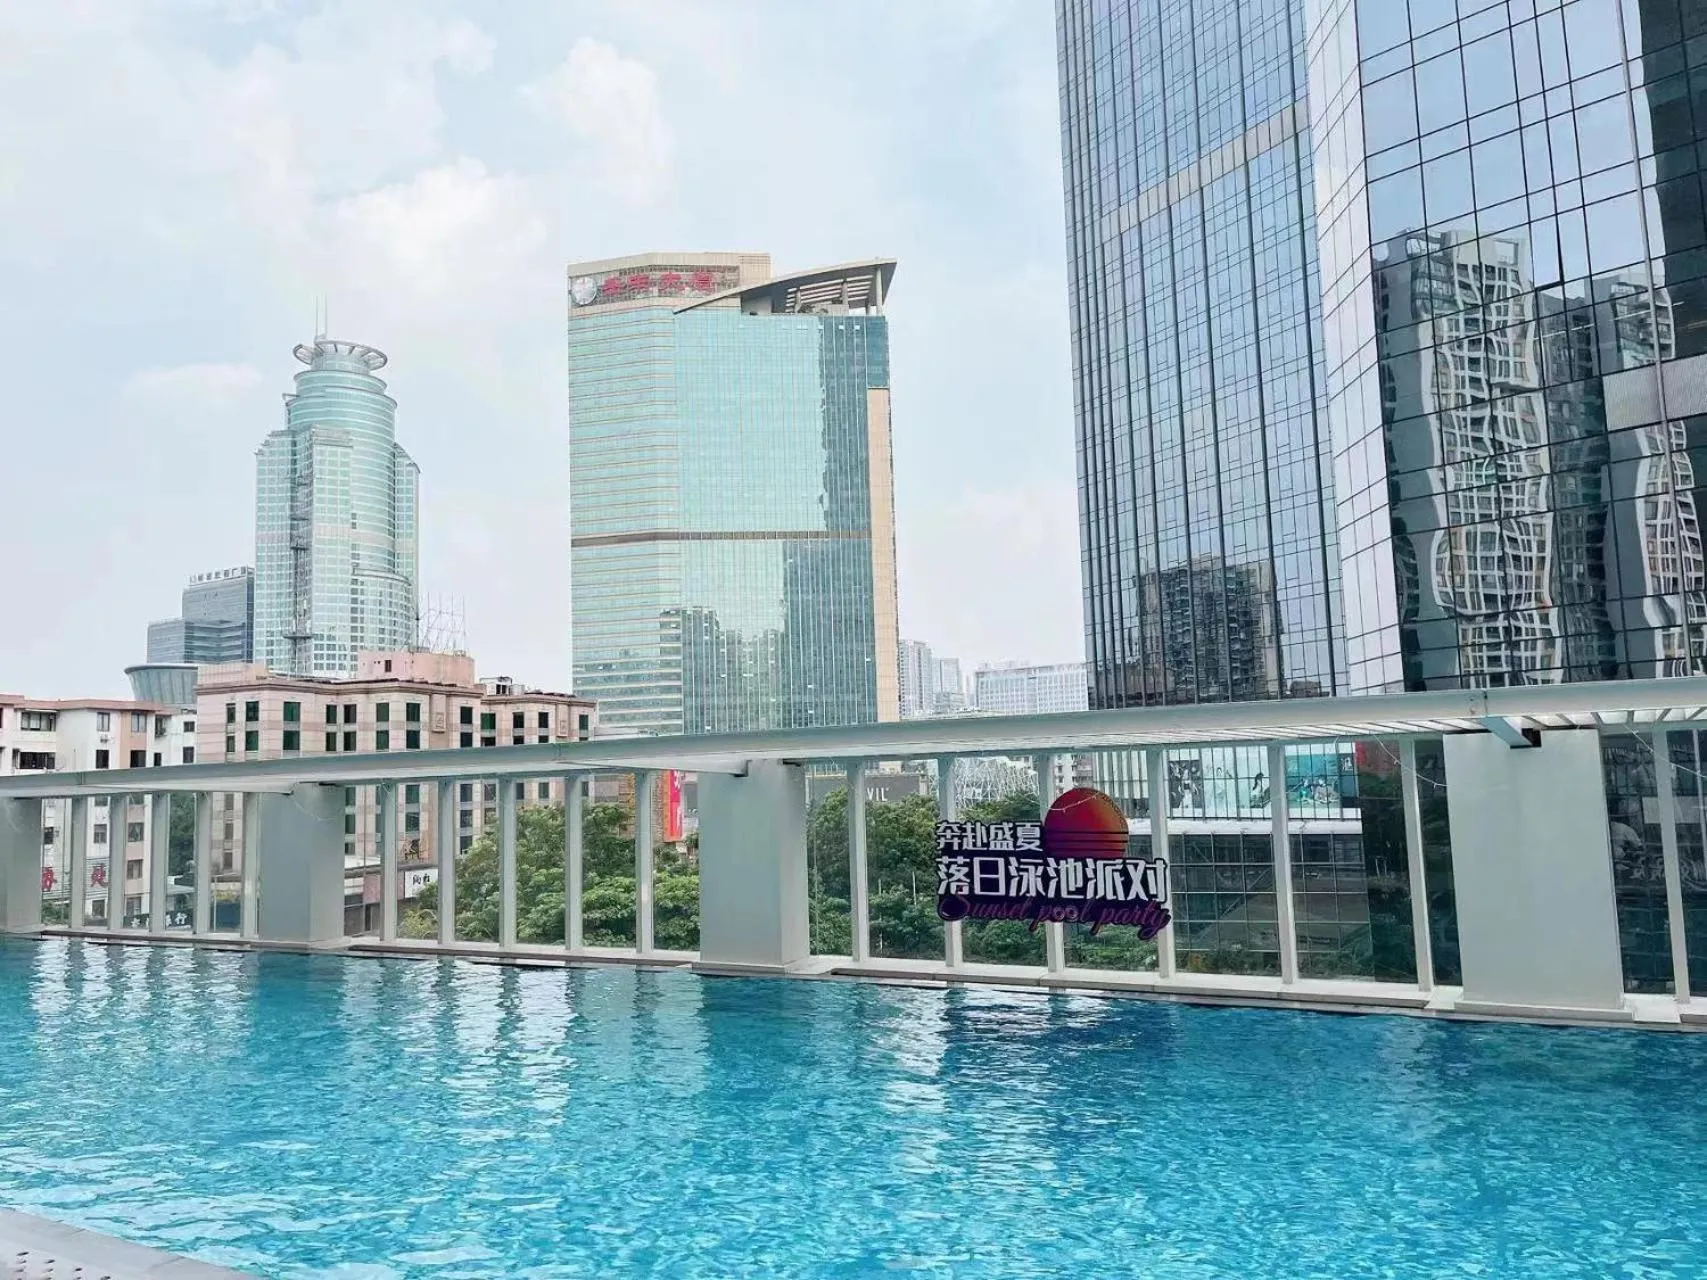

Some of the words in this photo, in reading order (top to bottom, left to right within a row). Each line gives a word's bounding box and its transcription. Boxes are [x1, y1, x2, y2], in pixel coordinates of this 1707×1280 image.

[936, 821, 1043, 852] 奔赴盛夏
[937, 855, 1167, 903] 落日泳池派对
[939, 894, 1033, 920] Sunset
[1029, 898, 1090, 932] pool
[1091, 900, 1171, 940] party
